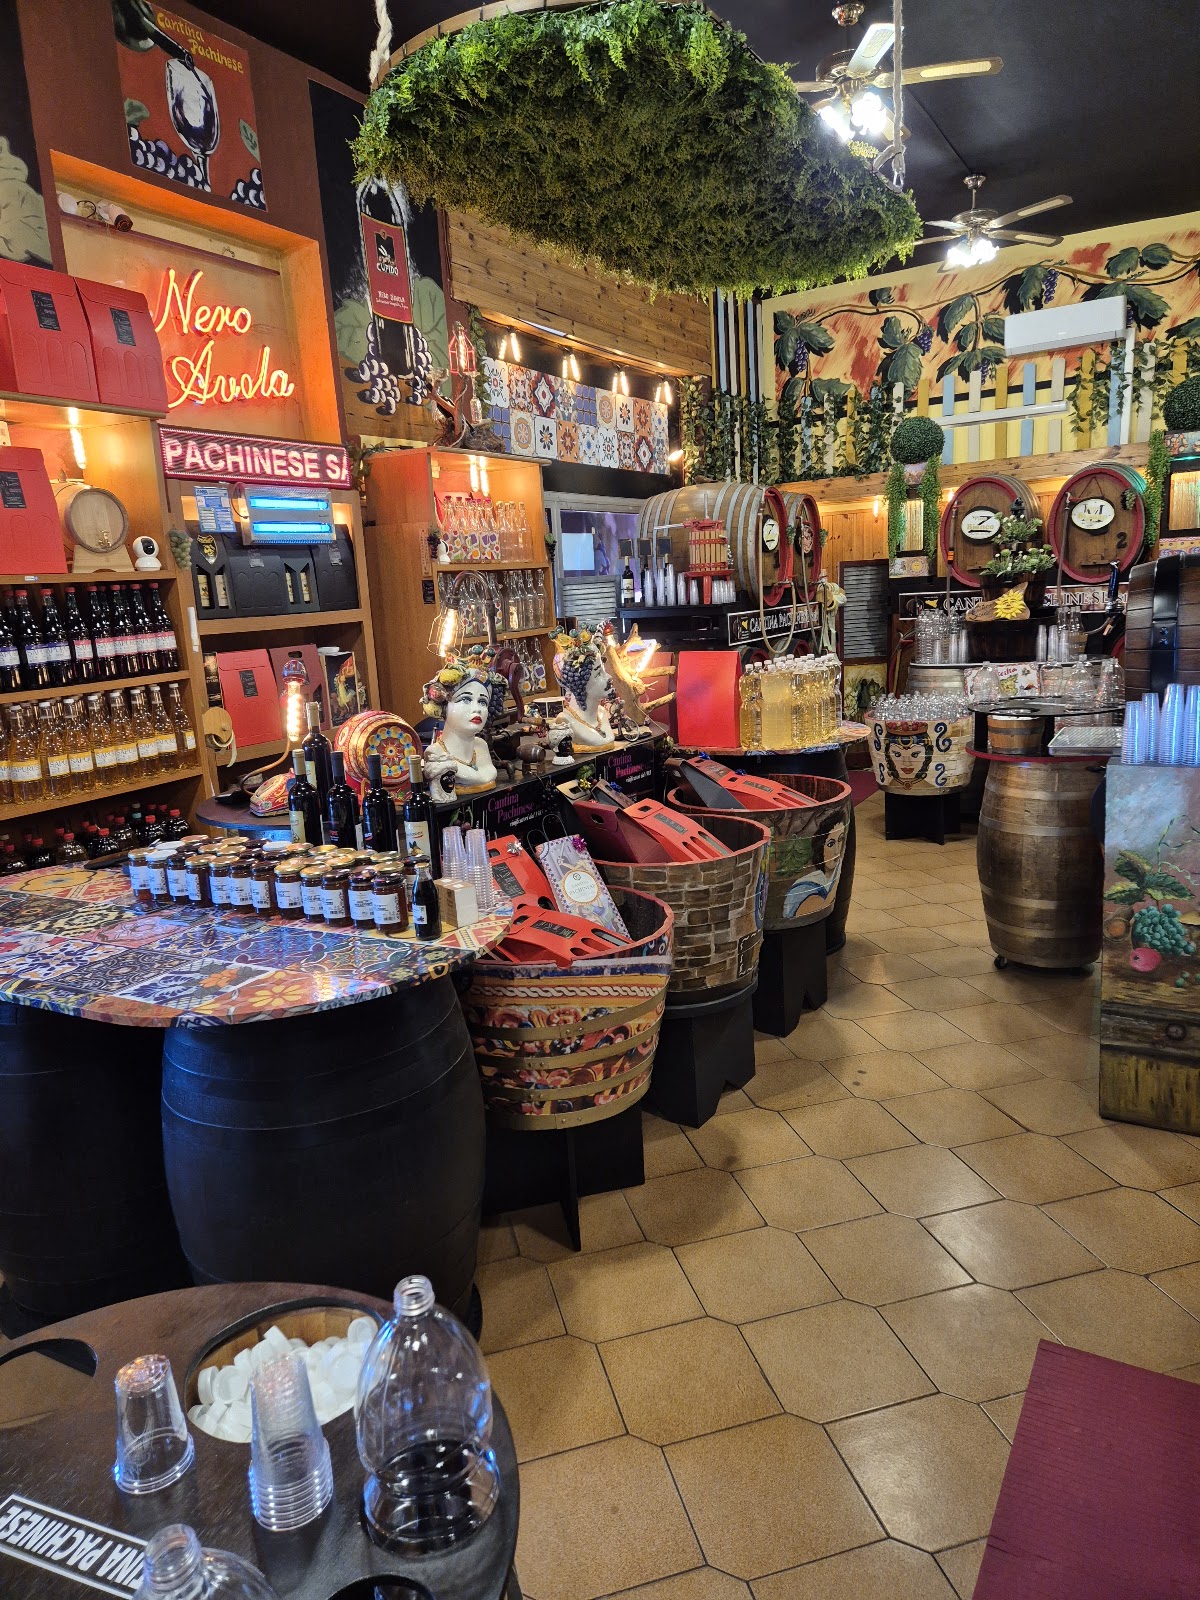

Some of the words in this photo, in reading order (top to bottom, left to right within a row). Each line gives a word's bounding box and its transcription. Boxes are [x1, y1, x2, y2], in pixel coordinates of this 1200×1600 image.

[156, 12, 205, 43] Cantina
[188, 38, 244, 74] Pachinese
[376, 262, 399, 276] CUPIDO
[154, 268, 252, 335] Nero
[168, 339, 295, 408] Avola
[165, 437, 321, 480] PACHINESE
[1116, 531, 1127, 549] 2
[607, 753, 632, 768] Cantina
[487, 793, 519, 812] Cantina
[497, 802, 535, 823] Pachinese
[0, 1504, 103, 1573] PACHINESE
